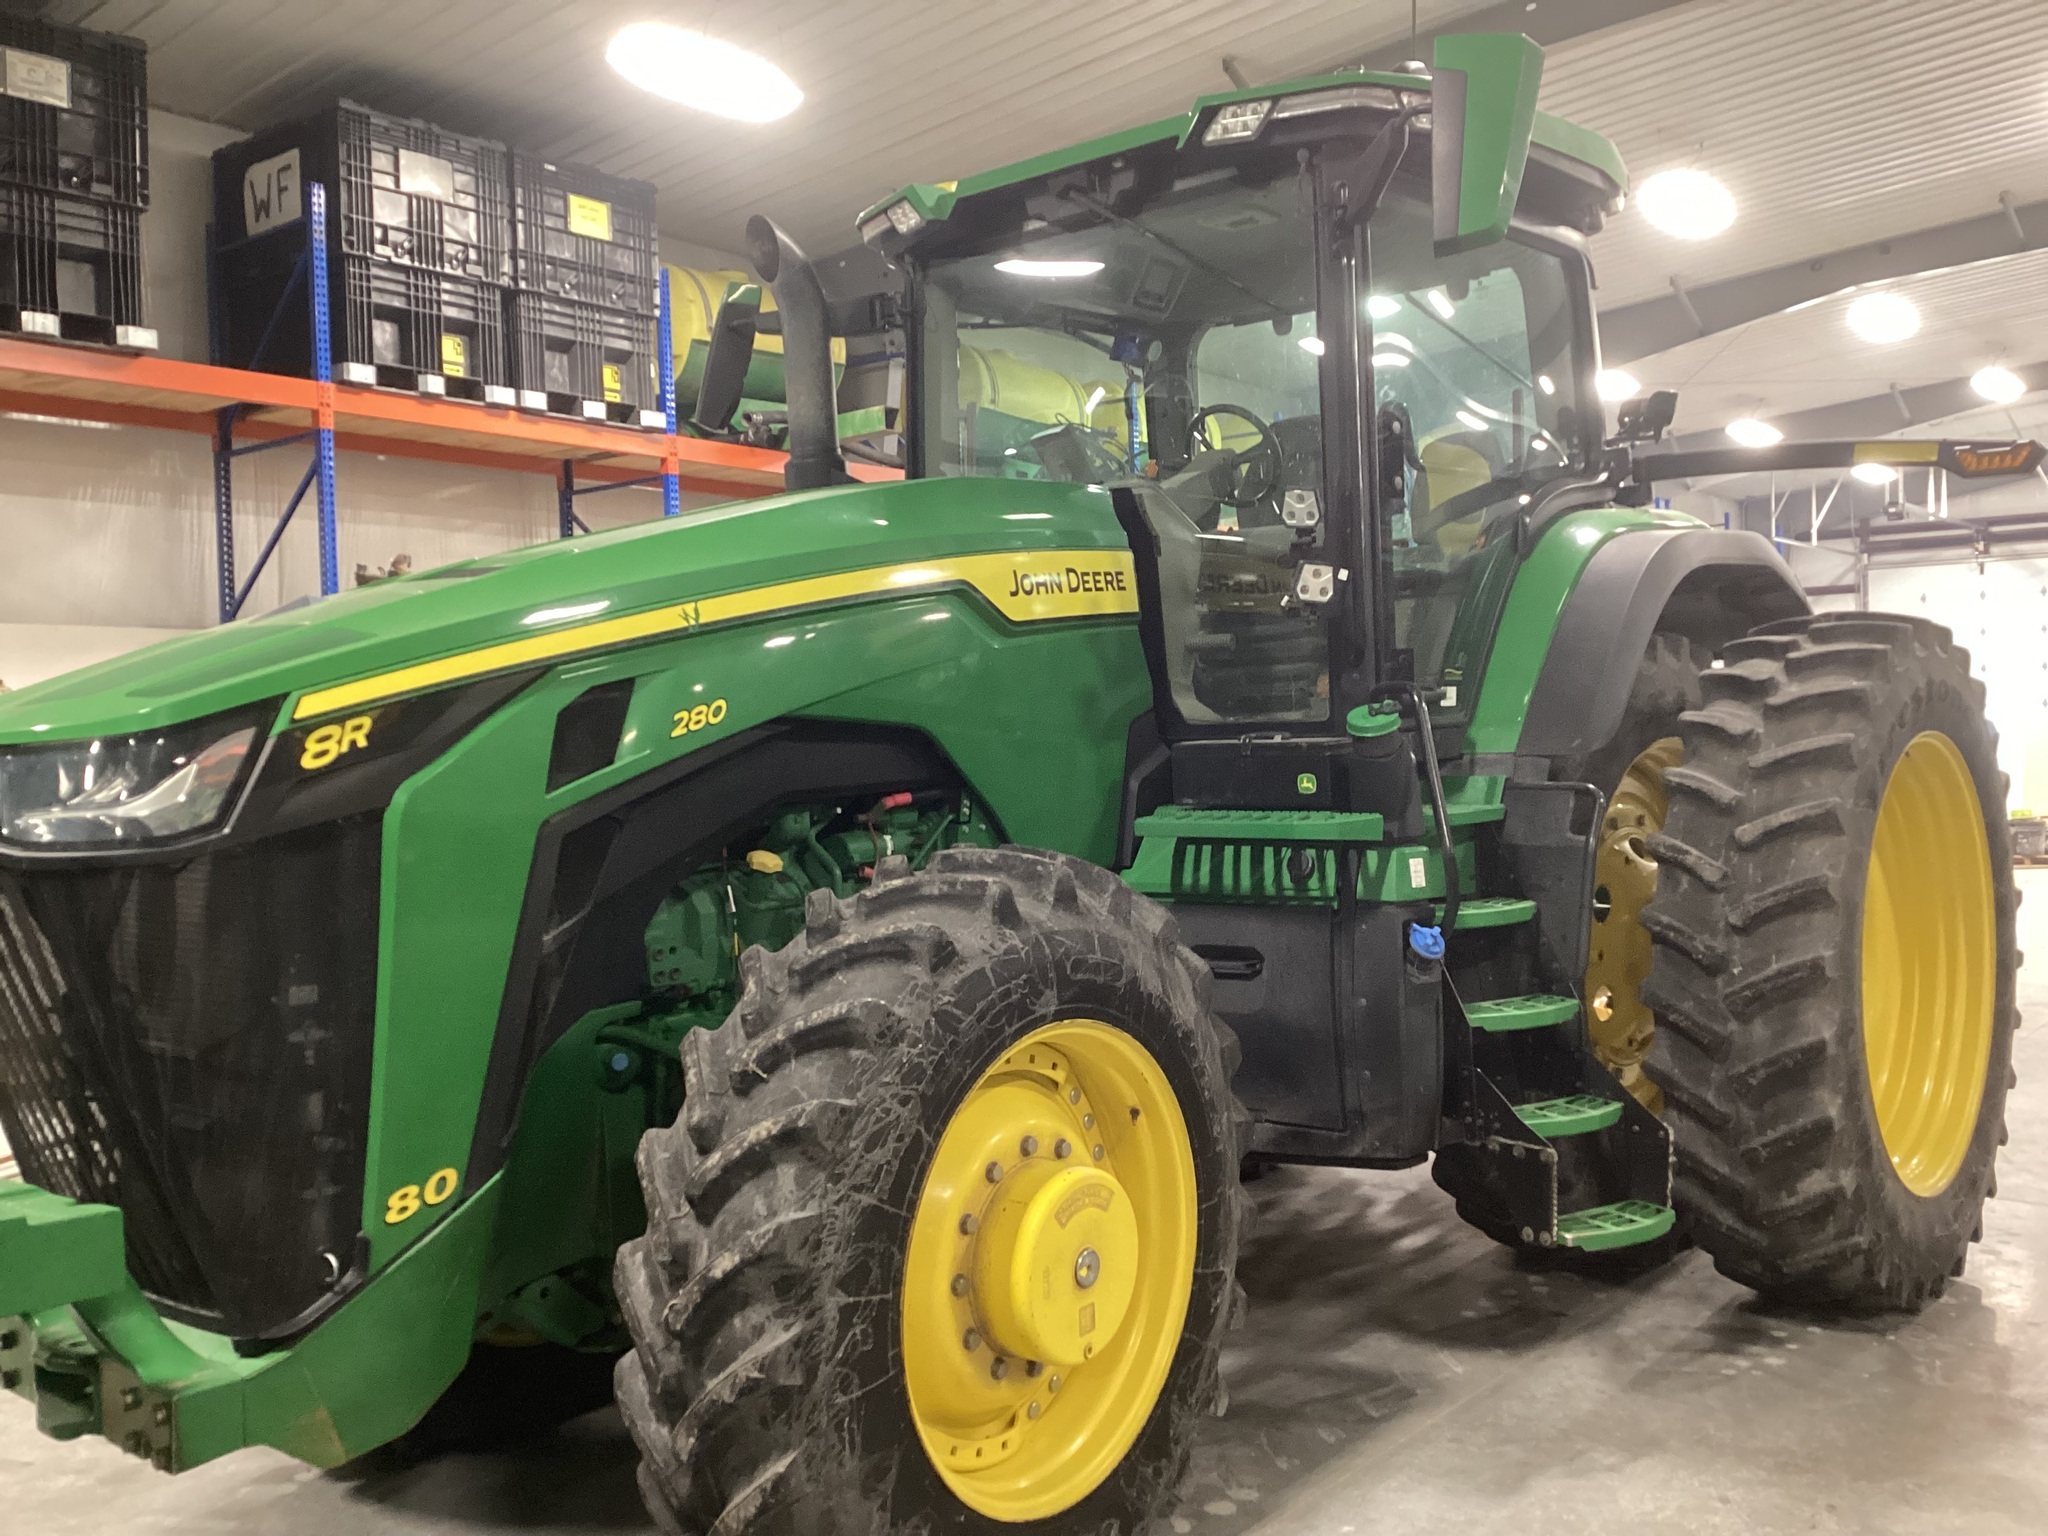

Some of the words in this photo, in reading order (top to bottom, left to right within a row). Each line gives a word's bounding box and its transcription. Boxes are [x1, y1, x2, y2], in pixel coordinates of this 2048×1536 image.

[250, 163, 292, 224] WF
[1009, 569, 1063, 597] JOHN
[1065, 567, 1127, 593] DEERE
[300, 715, 373, 770] 8R
[670, 698, 727, 738] 280
[385, 1167, 458, 1224] 80
